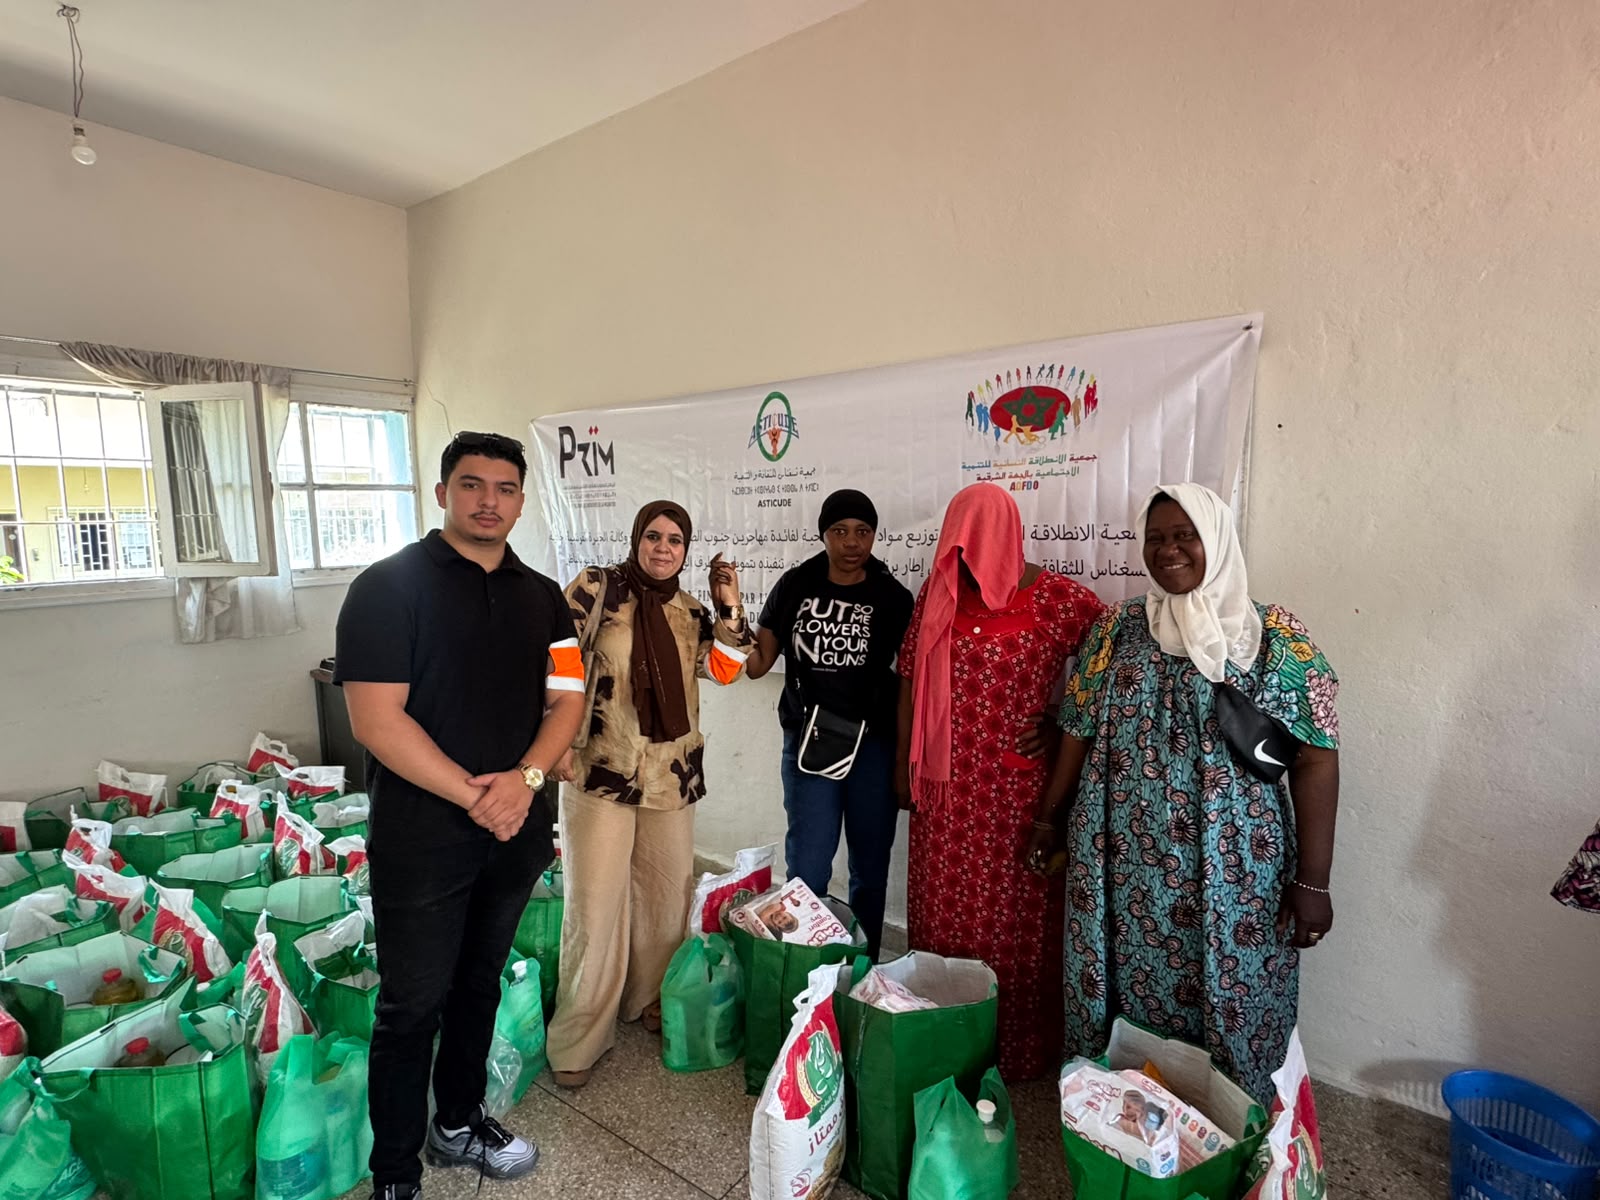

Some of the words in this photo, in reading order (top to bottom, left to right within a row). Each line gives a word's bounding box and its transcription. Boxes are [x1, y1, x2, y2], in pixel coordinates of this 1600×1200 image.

[1028, 453, 1067, 466] الانطلاقة
[1069, 453, 1097, 463] جمعية
[757, 498, 792, 508] ASTICUDE
[704, 531, 730, 546] جنوب
[732, 528, 769, 546] مهاجرين
[770, 529, 799, 542] لفائدة
[877, 527, 903, 547] مواد
[905, 528, 939, 549] توزيع
[1030, 524, 1095, 542] الانطلاقة
[758, 556, 785, 573] تنفيذه
[901, 557, 925, 578] إطار
[1090, 559, 1147, 580] سغناس
[796, 597, 853, 622] PUT
[852, 603, 874, 615] SO
[850, 612, 871, 625] ME
[792, 619, 871, 638] FLOWERS
[822, 635, 869, 652] YOUR
[821, 651, 867, 666] GUNS
